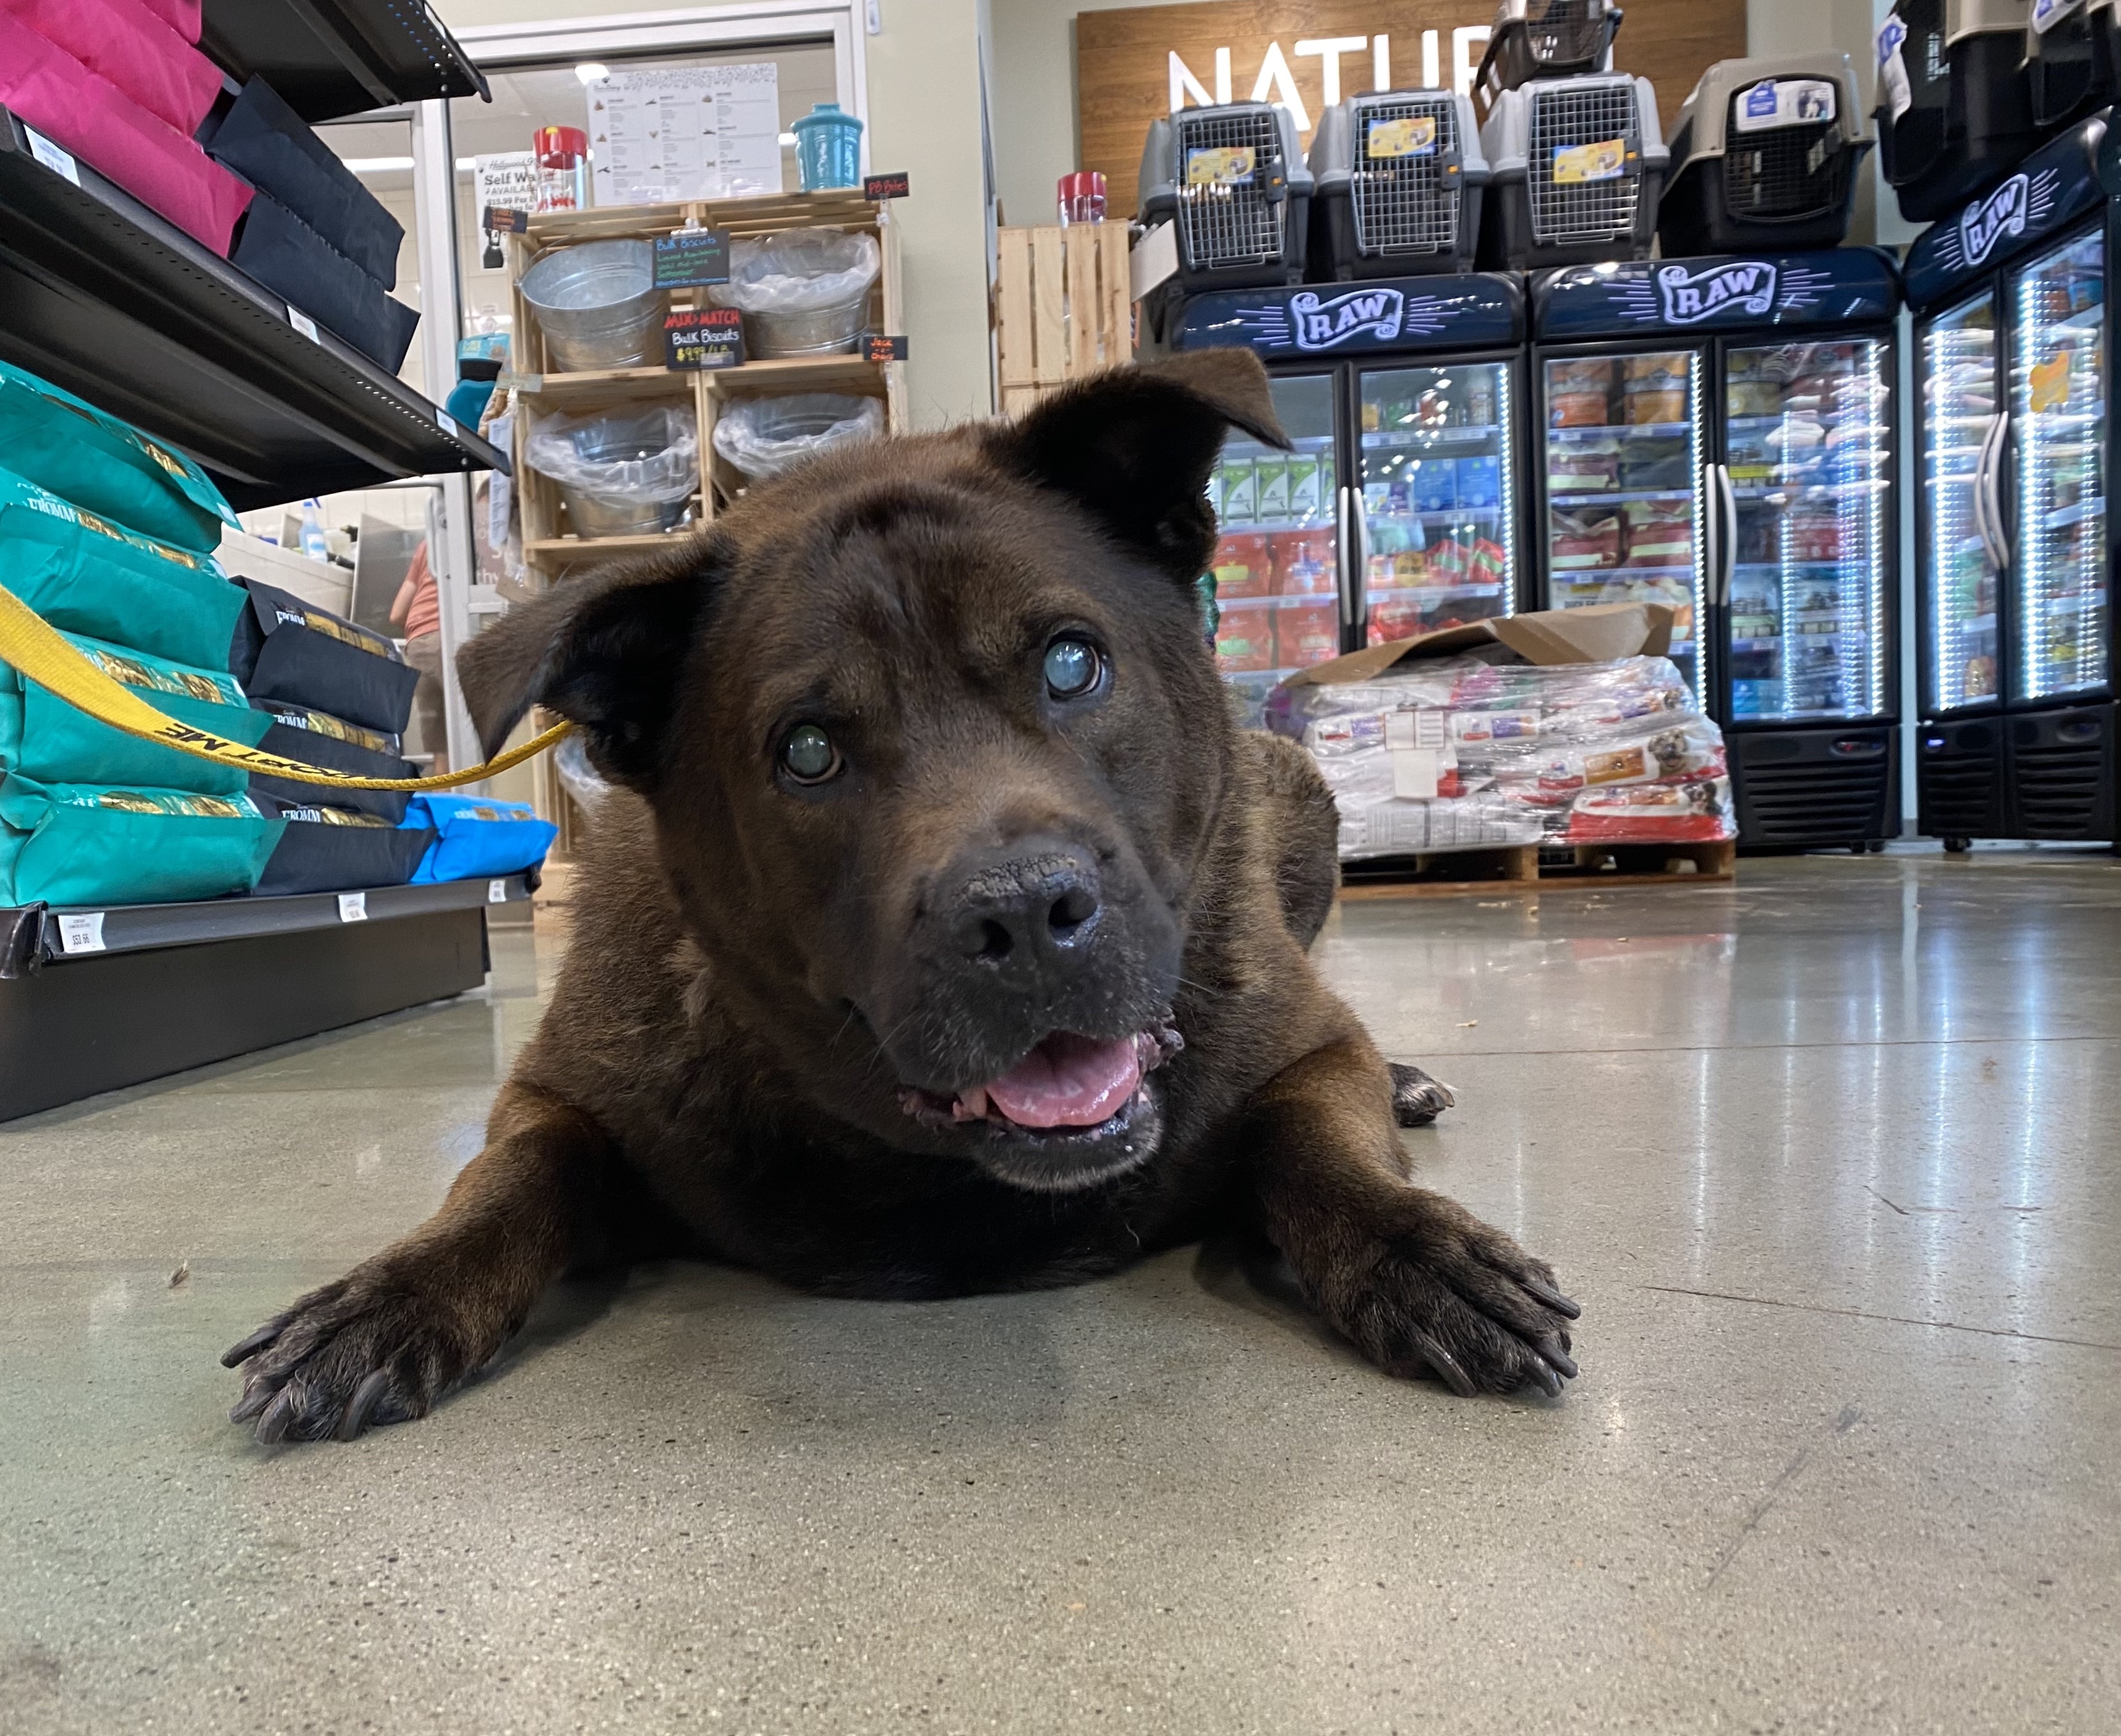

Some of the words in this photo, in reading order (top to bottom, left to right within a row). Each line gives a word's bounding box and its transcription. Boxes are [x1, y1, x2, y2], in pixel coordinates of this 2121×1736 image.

[485, 172, 511, 185] Self
[1968, 183, 2018, 255] RAW
[656, 239, 677, 251] Bulk
[681, 236, 716, 249] Biscuits
[1676, 267, 1760, 320] RAW
[1308, 294, 1388, 340] RAW
[701, 328, 739, 343] Biscuits
[27, 498, 75, 523] FROMM
[273, 714, 307, 730] ROMM
[154, 723, 229, 752] ME
[281, 810, 321, 823] FROMM
